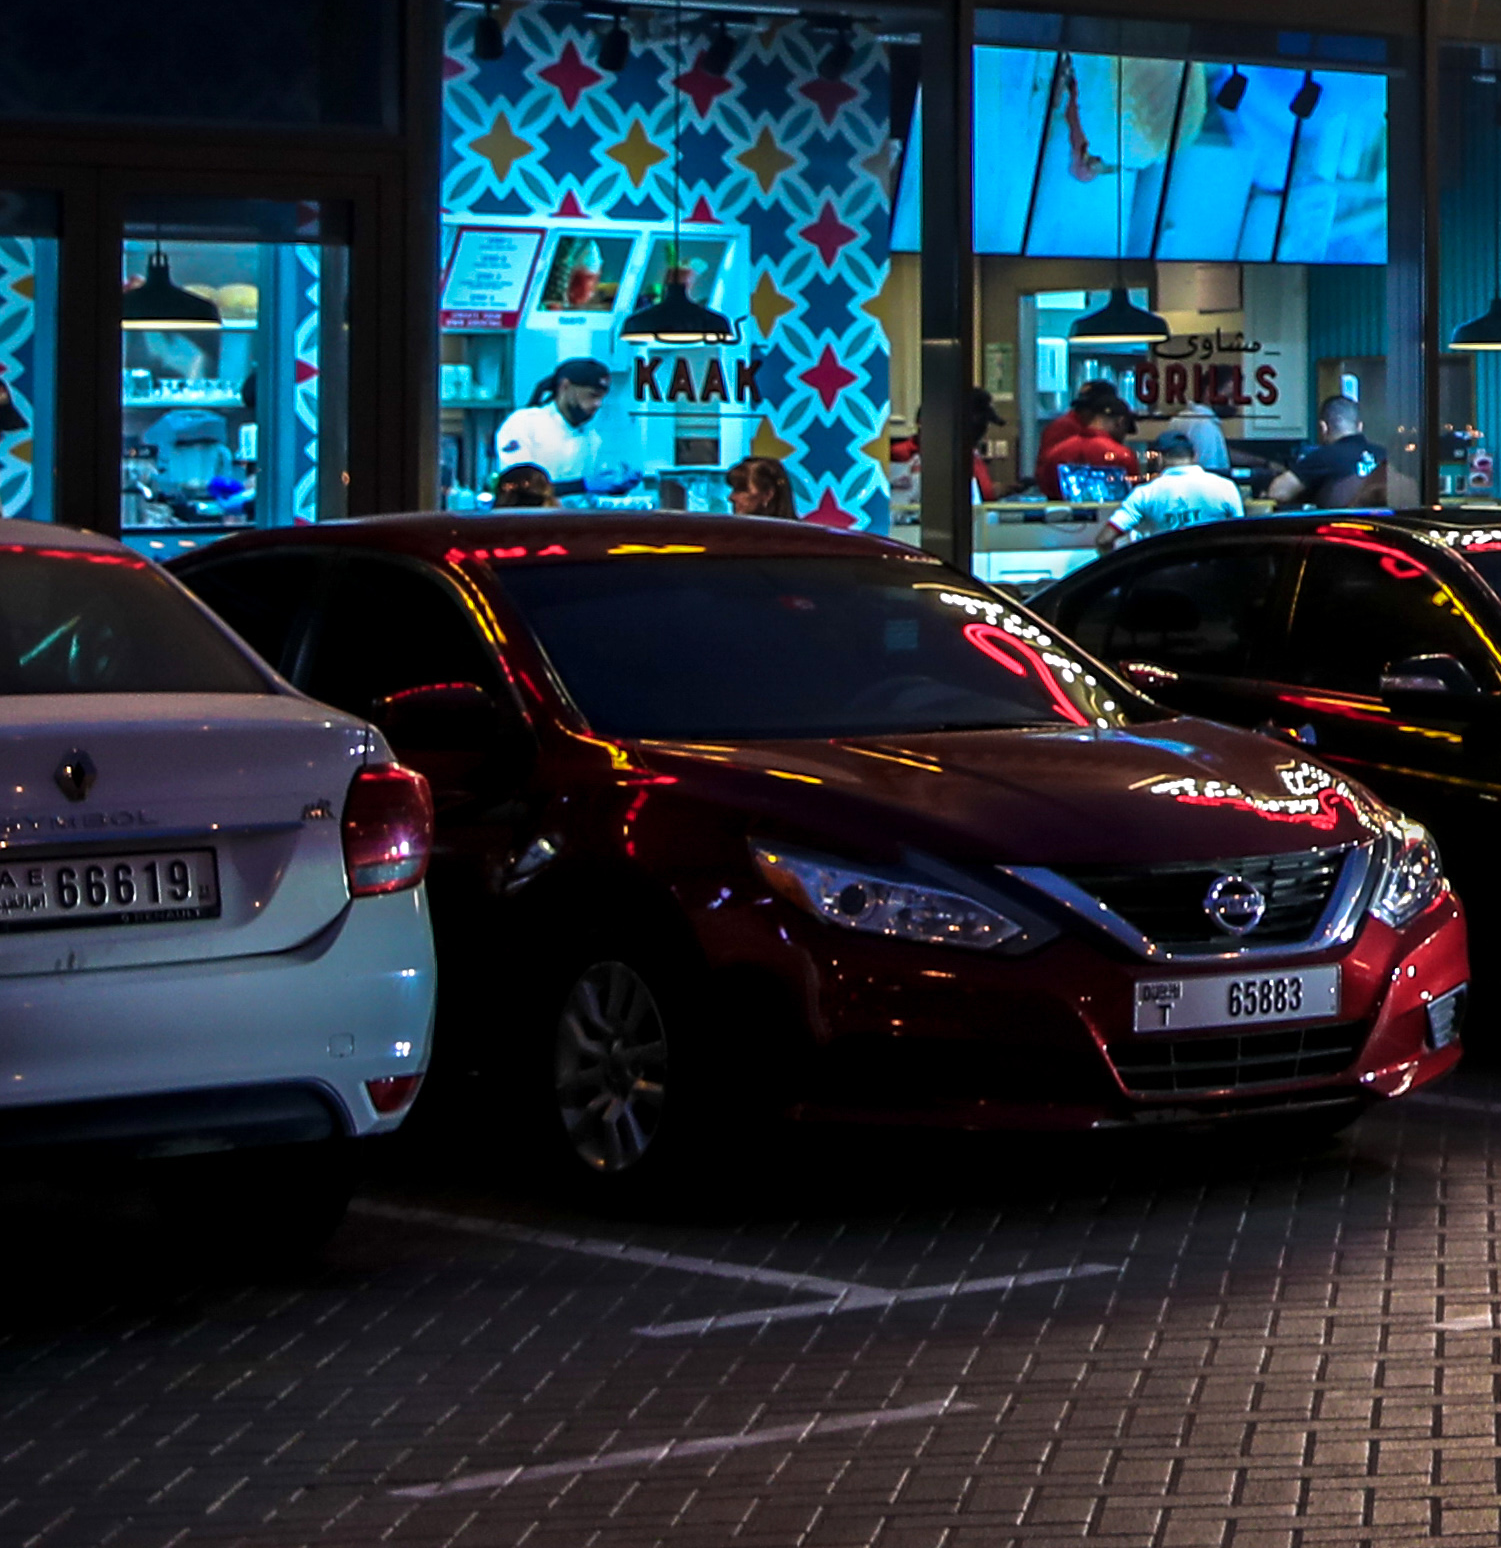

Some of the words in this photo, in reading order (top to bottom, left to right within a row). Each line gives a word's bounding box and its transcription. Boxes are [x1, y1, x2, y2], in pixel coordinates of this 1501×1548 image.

[634, 356, 763, 403] KAAK
[1135, 363, 1279, 406] GRILLS
[57, 859, 194, 909] 66619
[1157, 1002, 1175, 1027] T
[1228, 976, 1303, 1017] 65883
